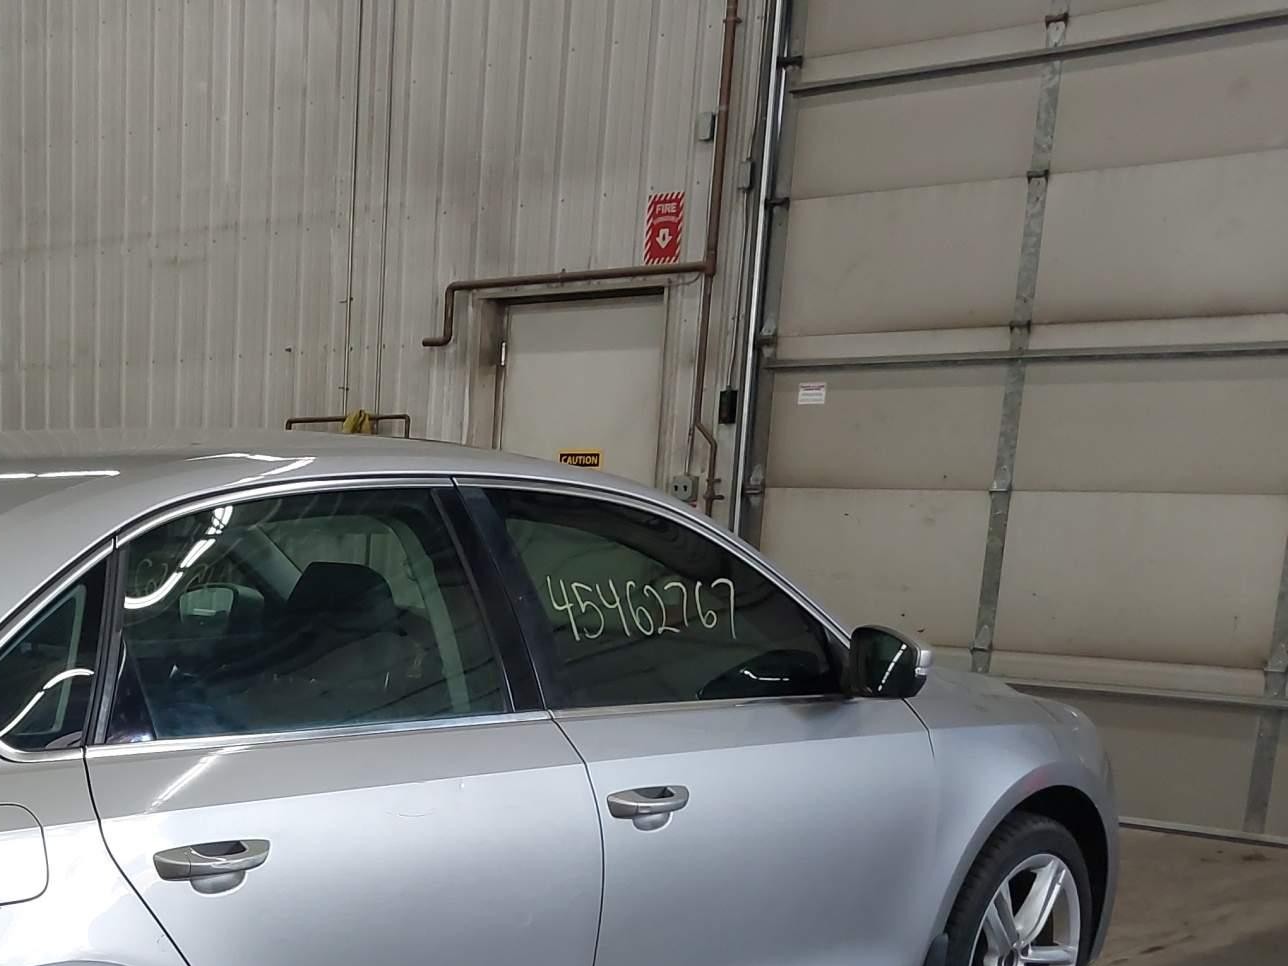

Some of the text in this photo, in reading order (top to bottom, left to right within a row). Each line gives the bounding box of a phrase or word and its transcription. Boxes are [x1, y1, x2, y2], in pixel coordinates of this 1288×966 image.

[656, 203, 677, 214] FIRE
[562, 455, 598, 465] CAUTION
[547, 576, 736, 641] 45462767
